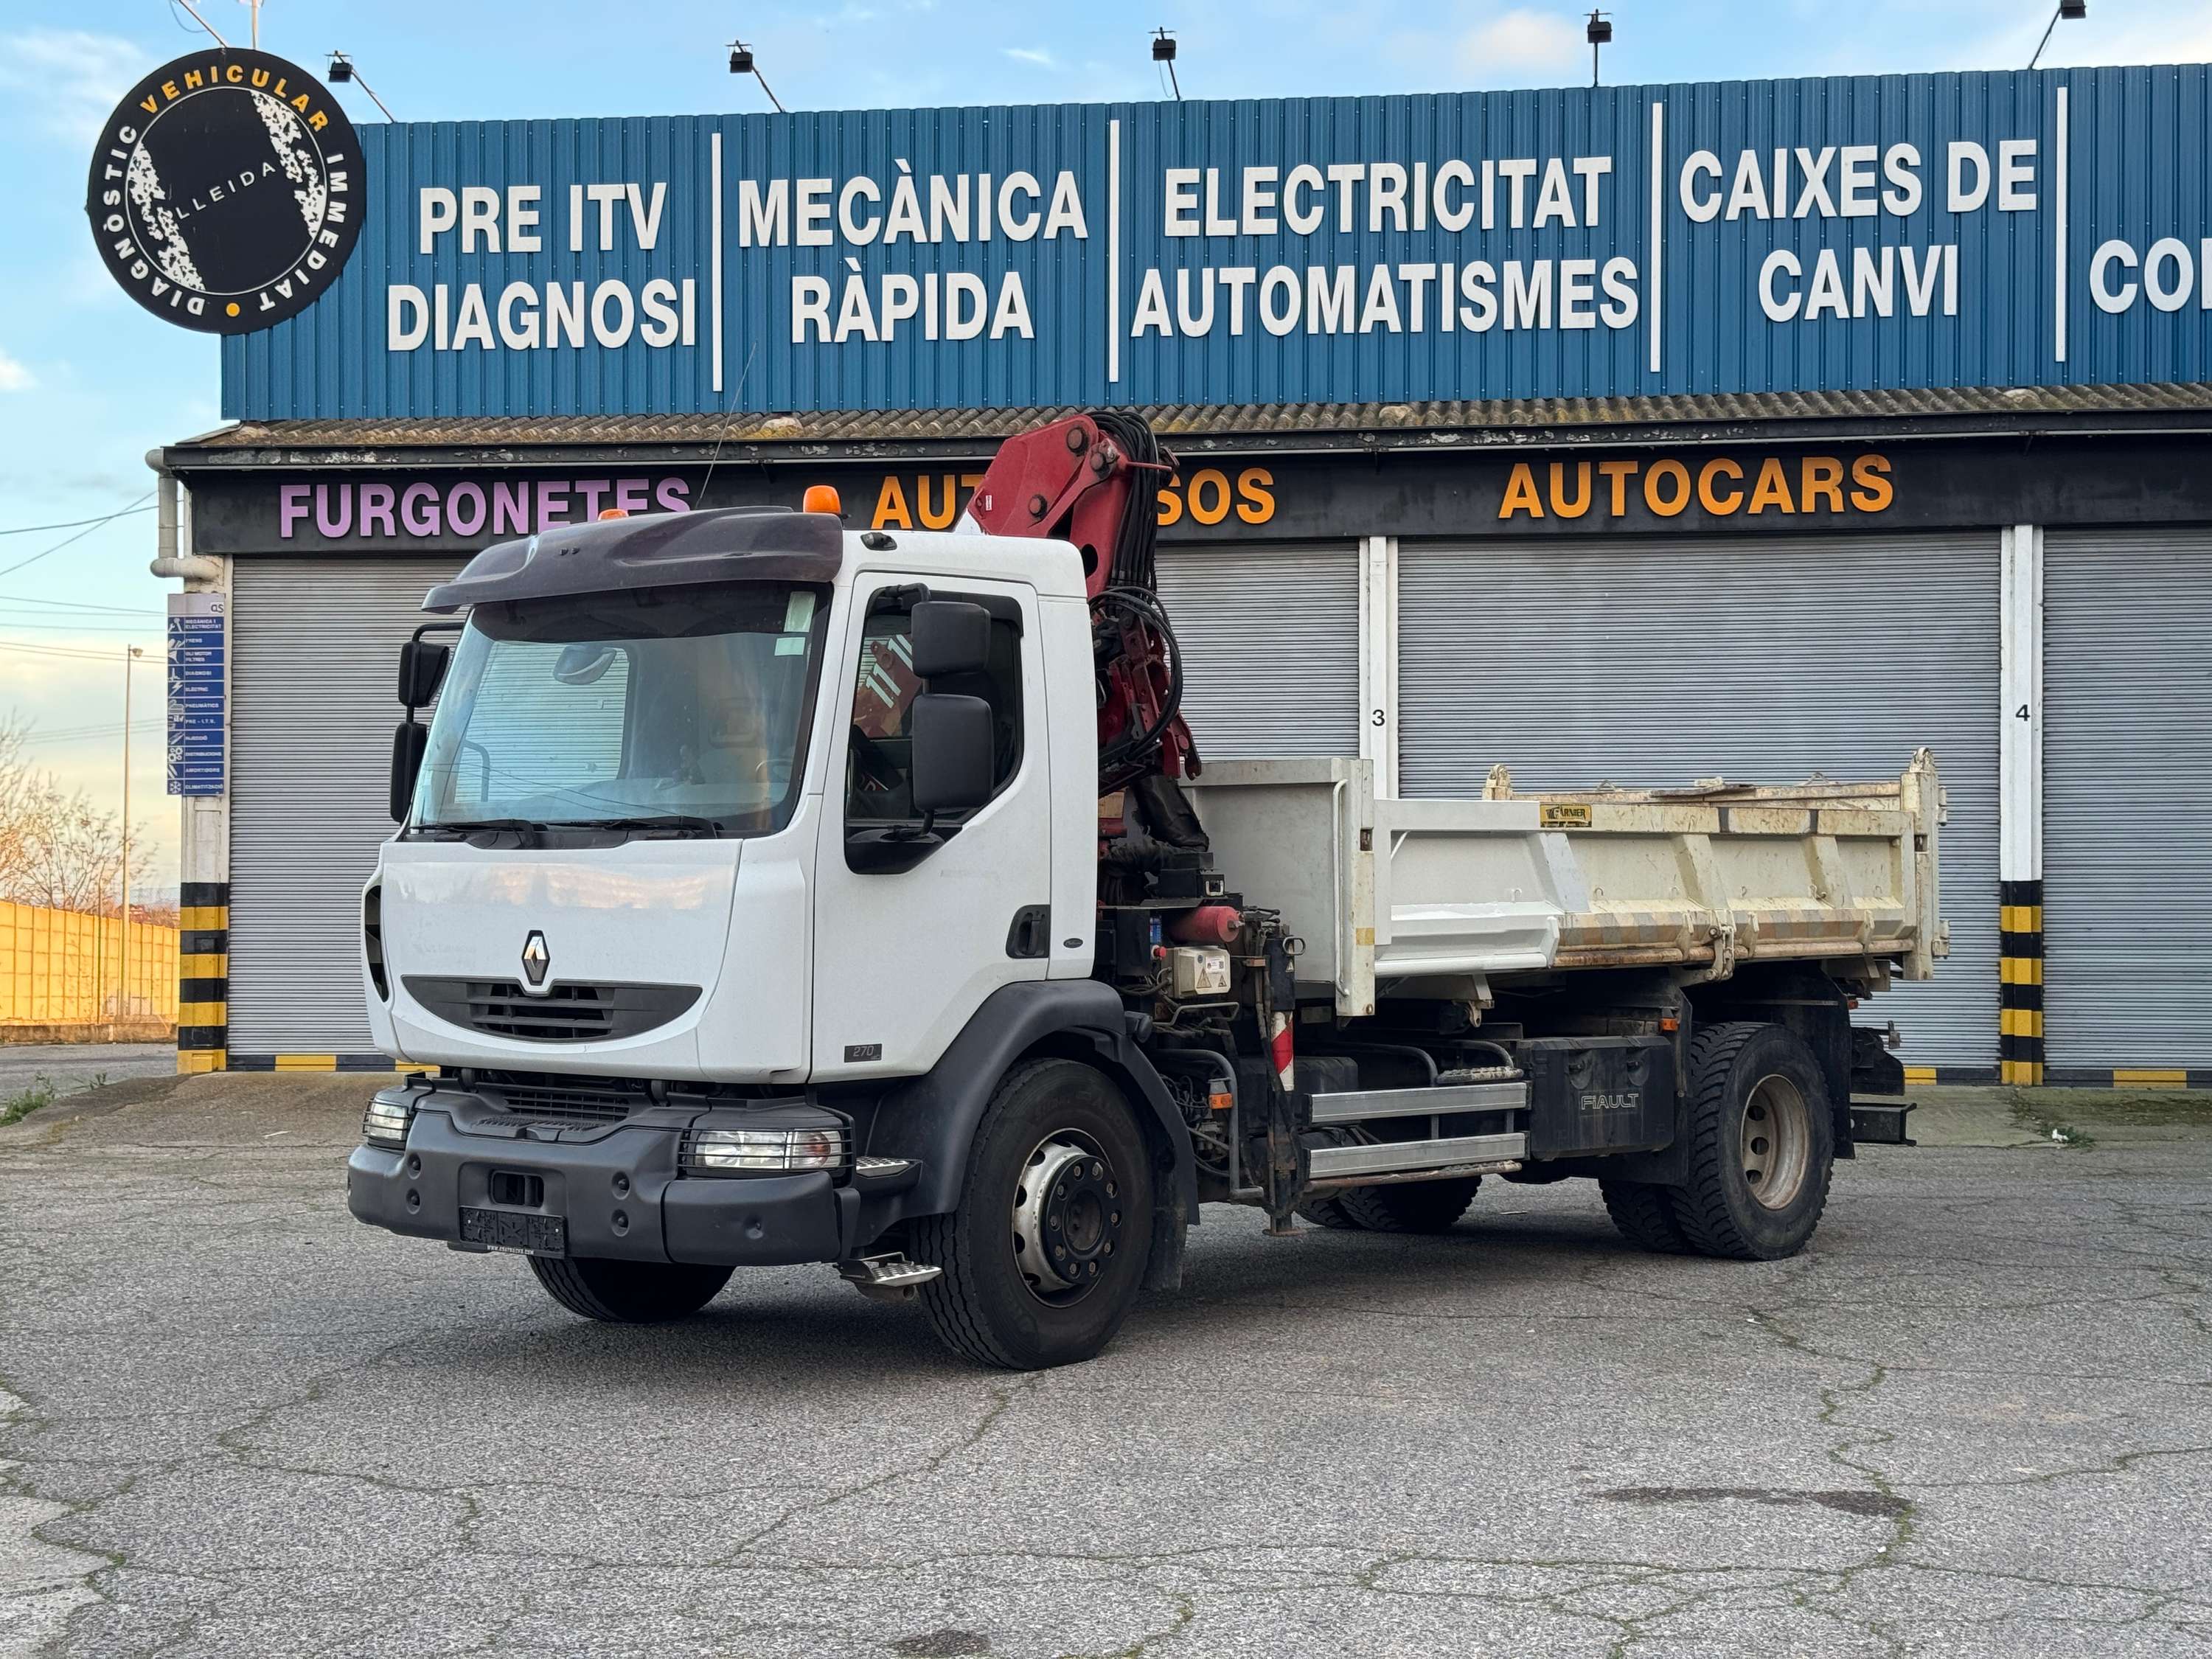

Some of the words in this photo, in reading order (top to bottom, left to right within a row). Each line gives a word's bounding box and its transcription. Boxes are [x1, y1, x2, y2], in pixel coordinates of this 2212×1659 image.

[139, 64, 330, 133] VEHICULAR
[175, 161, 277, 220] LLEIDA
[420, 185, 542, 254] PRE
[570, 181, 668, 252] ITV
[738, 158, 1089, 248] MECÀNICA
[1164, 156, 1613, 237] ELECTRICITAT
[1680, 142, 1923, 223] CAIXES
[1947, 139, 2038, 214] DE
[102, 125, 206, 316] DIAGNÒSTIC
[258, 153, 349, 313] IMMEDIAT
[791, 257, 1035, 344] RÀPIDA
[1131, 256, 1640, 338] AUTOMATISMES
[1758, 244, 1959, 323] CANVI
[2090, 237, 2212, 314] CO
[387, 277, 696, 352] DIAGNOSI
[280, 478, 690, 538] FURGONETES
[1498, 456, 1893, 519] AUTOCARS
[1372, 709, 1385, 726] 3
[2015, 704, 2031, 722] 4
[853, 1045, 874, 1057] 270
